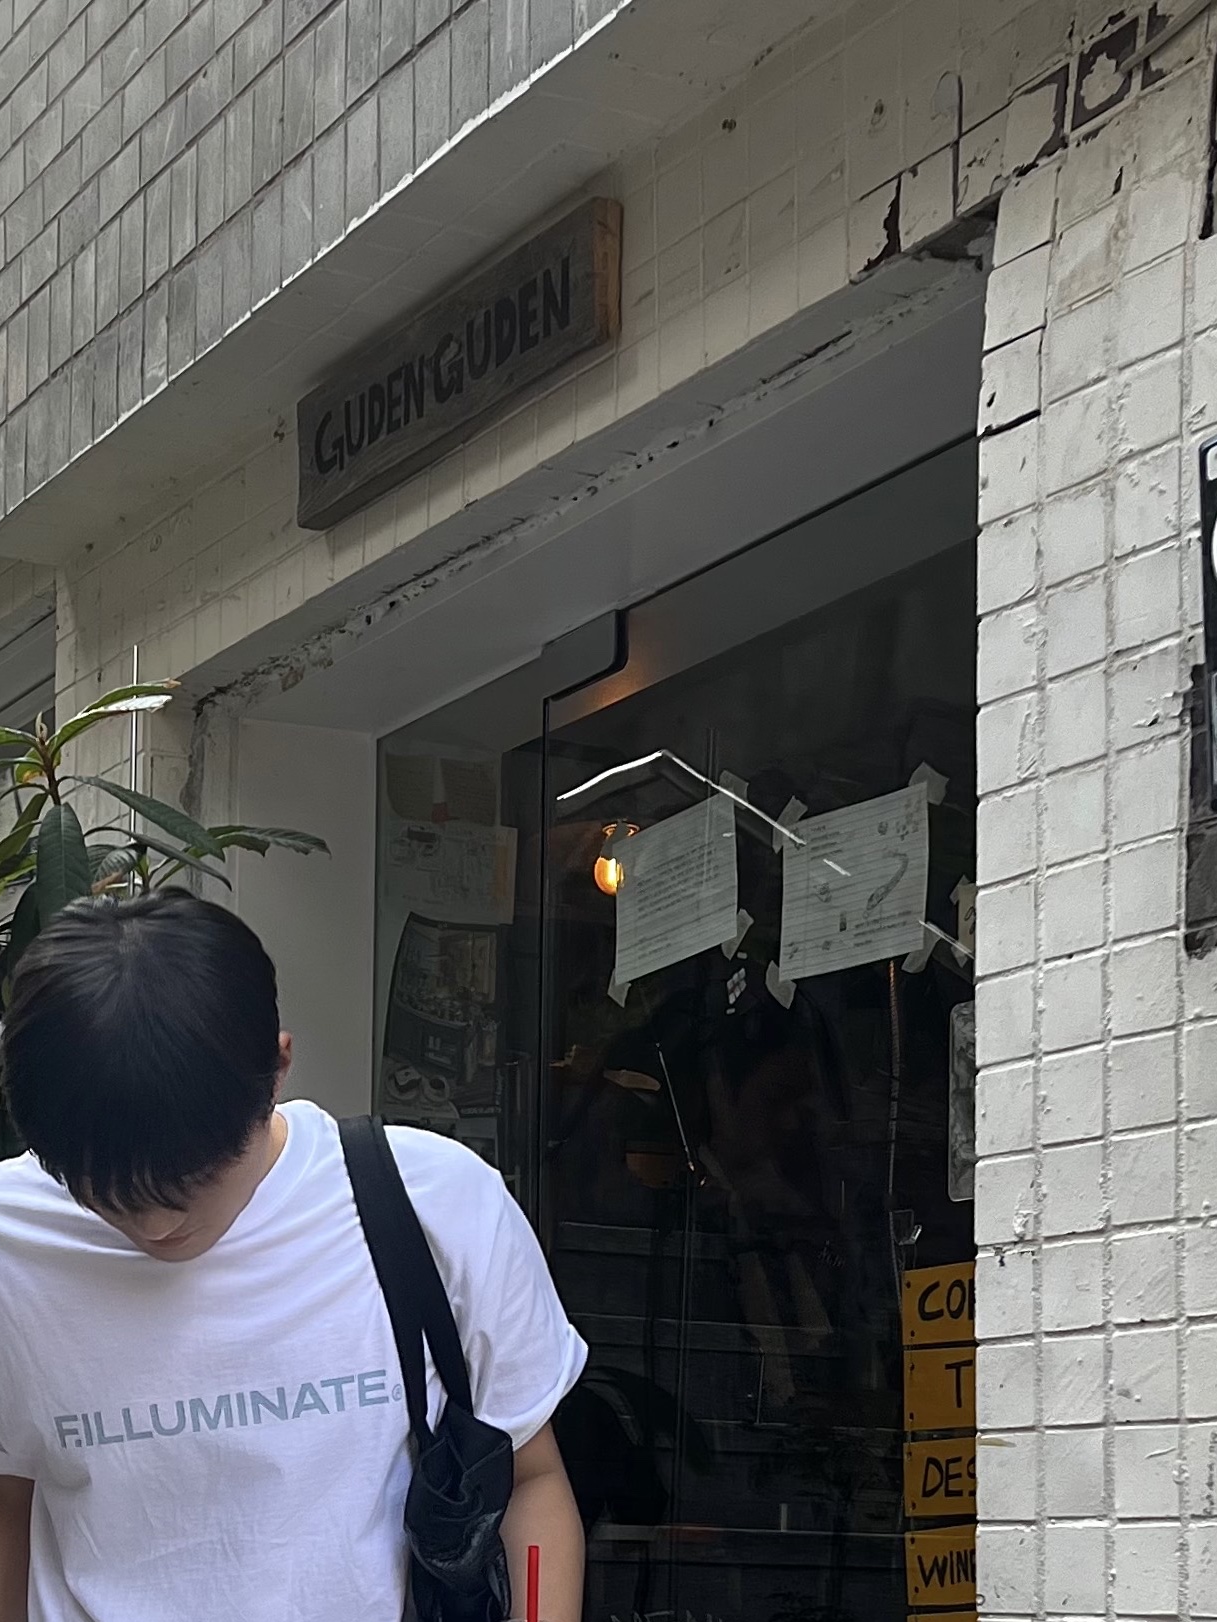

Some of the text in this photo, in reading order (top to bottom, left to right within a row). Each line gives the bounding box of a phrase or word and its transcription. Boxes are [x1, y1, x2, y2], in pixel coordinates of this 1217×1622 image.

[314, 256, 570, 475] GUDEN GUDEN
[918, 1279, 975, 1321] CO
